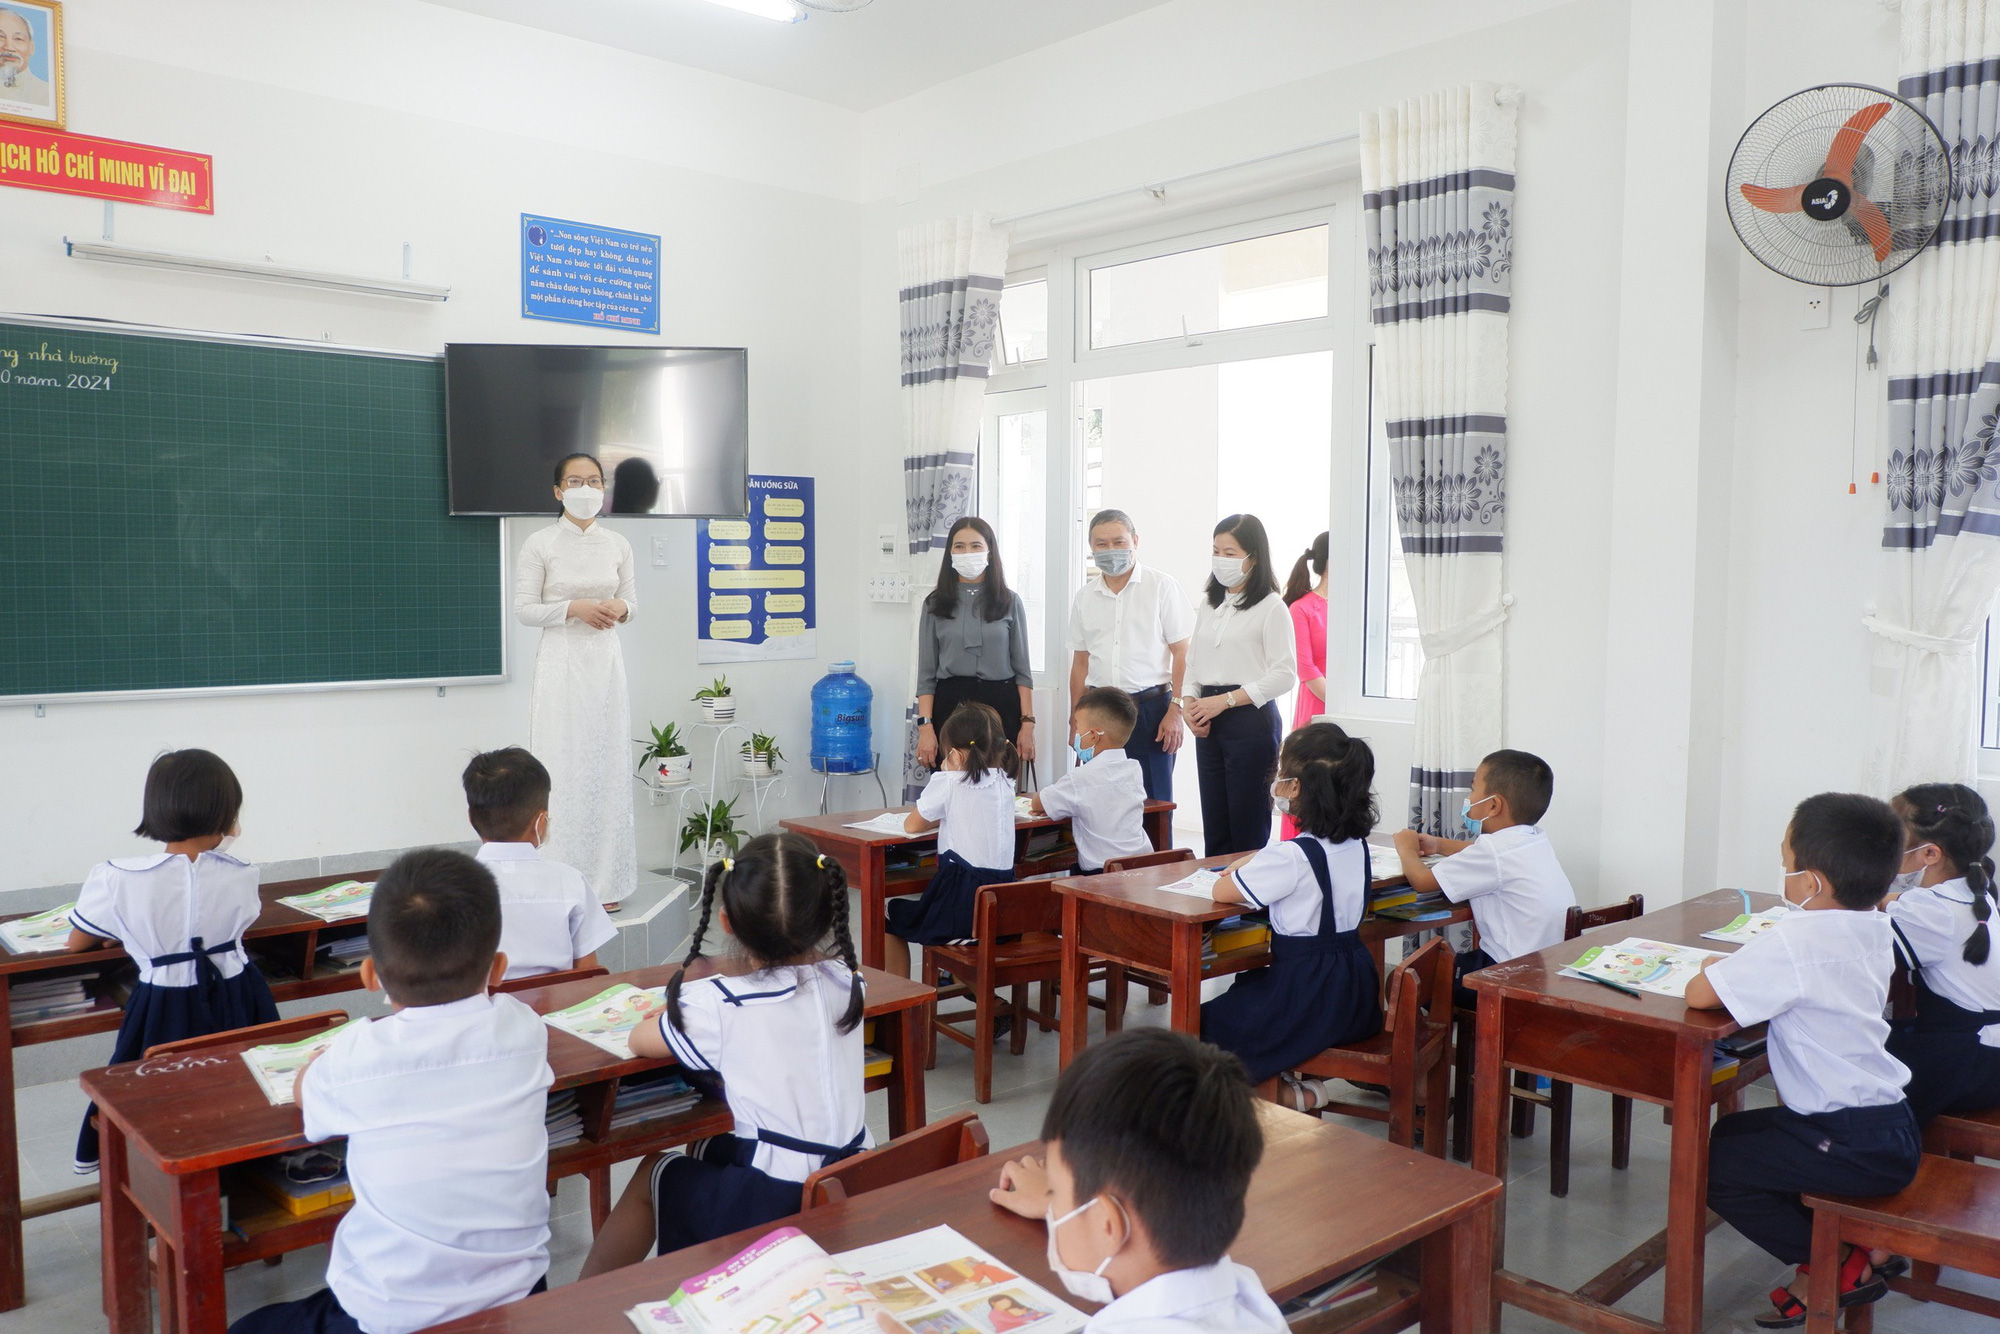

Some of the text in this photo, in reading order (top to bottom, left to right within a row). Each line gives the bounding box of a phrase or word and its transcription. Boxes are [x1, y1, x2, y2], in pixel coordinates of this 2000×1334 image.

[36, 142, 60, 175] HỒ
[65, 151, 94, 180] CHÍ
[99, 158, 144, 188] MINH
[148, 162, 164, 191] VĨ
[168, 168, 196, 200] ĐẠI
[590, 235, 604, 245] Việt
[605, 238, 619, 247] Nam
[551, 243, 565, 251] tươi
[585, 247, 597, 258] hay
[530, 252, 544, 262] Việt
[546, 254, 562, 264] Nam
[574, 259, 590, 268] bước
[634, 270, 653, 279] quang
[542, 268, 562, 277] sánh
[580, 273, 591, 281] với
[609, 278, 632, 289] cường
[634, 282, 652, 290] quốc
[580, 285, 591, 295] hay
[530, 293, 543, 301] một
[567, 297, 582, 307] công
[583, 299, 594, 308] học
[596, 301, 606, 310] tập
[619, 304, 629, 312] các
[27, 342, 63, 361] nhà
[67, 374, 110, 390] 2021
[761, 480, 782, 489] UỐNG
[784, 481, 798, 489] SỮA
[837, 713, 864, 725] Bigsun
